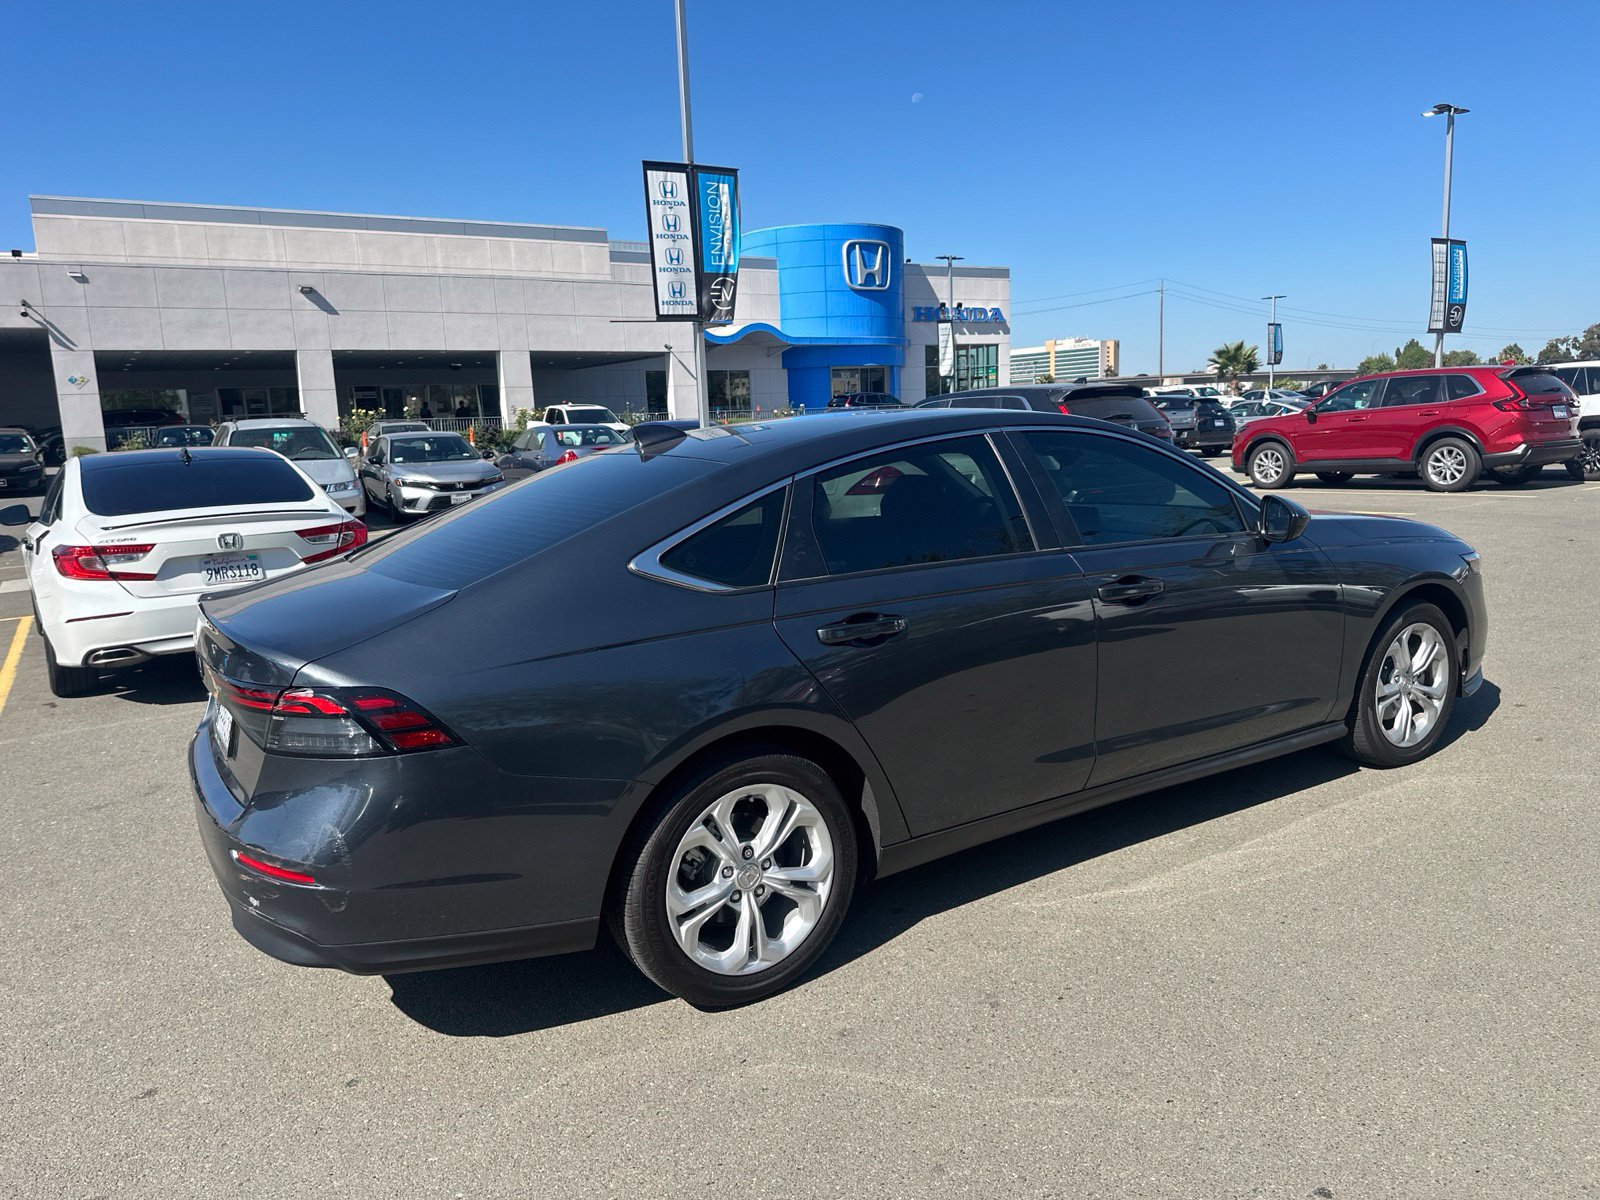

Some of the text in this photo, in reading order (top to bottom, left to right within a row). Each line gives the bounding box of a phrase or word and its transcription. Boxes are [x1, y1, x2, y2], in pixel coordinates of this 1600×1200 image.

[706, 181, 724, 265] ENVISION
[912, 307, 1007, 322] HONDA
[206, 563, 258, 581] 9MRS118
